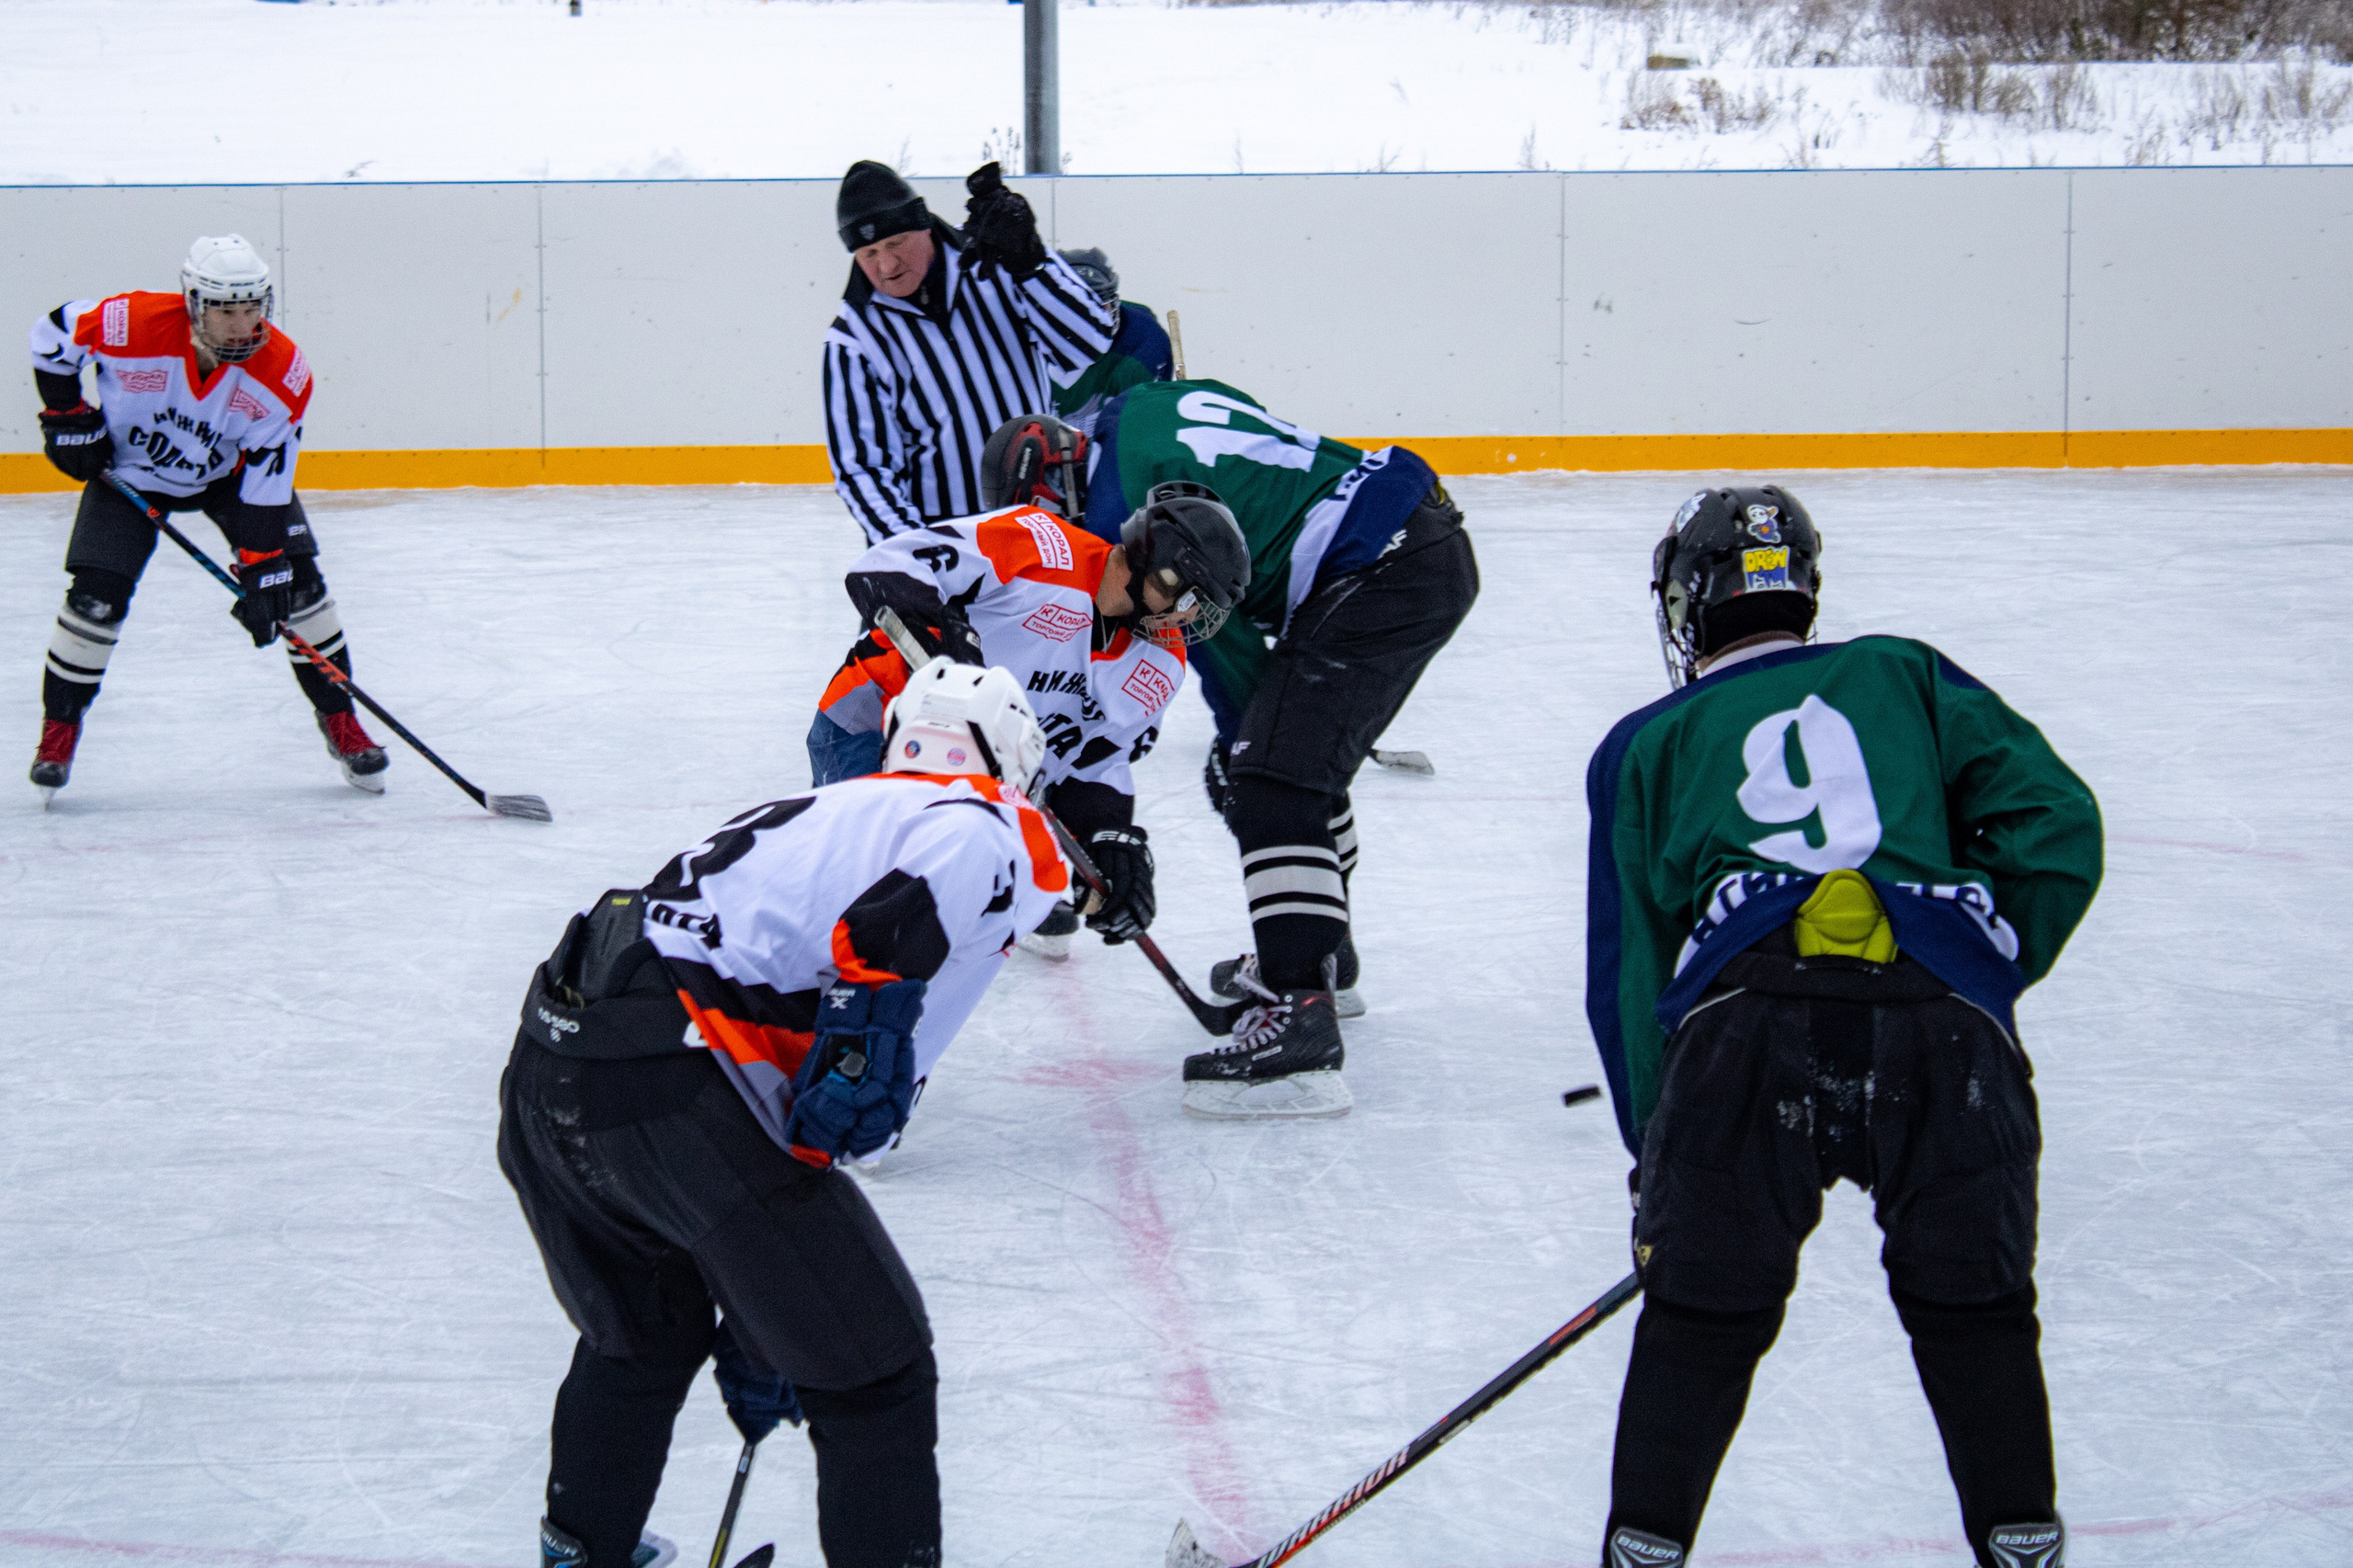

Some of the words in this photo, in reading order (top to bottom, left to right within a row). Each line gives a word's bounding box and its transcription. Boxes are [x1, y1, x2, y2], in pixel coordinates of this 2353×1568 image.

[1176, 391, 1321, 472] 12
[1046, 524, 1071, 566] КОРАЛ
[1736, 694, 1882, 874] 9
[1618, 1535, 1680, 1561] BAUER
[1995, 1531, 2060, 1545] BAUER
